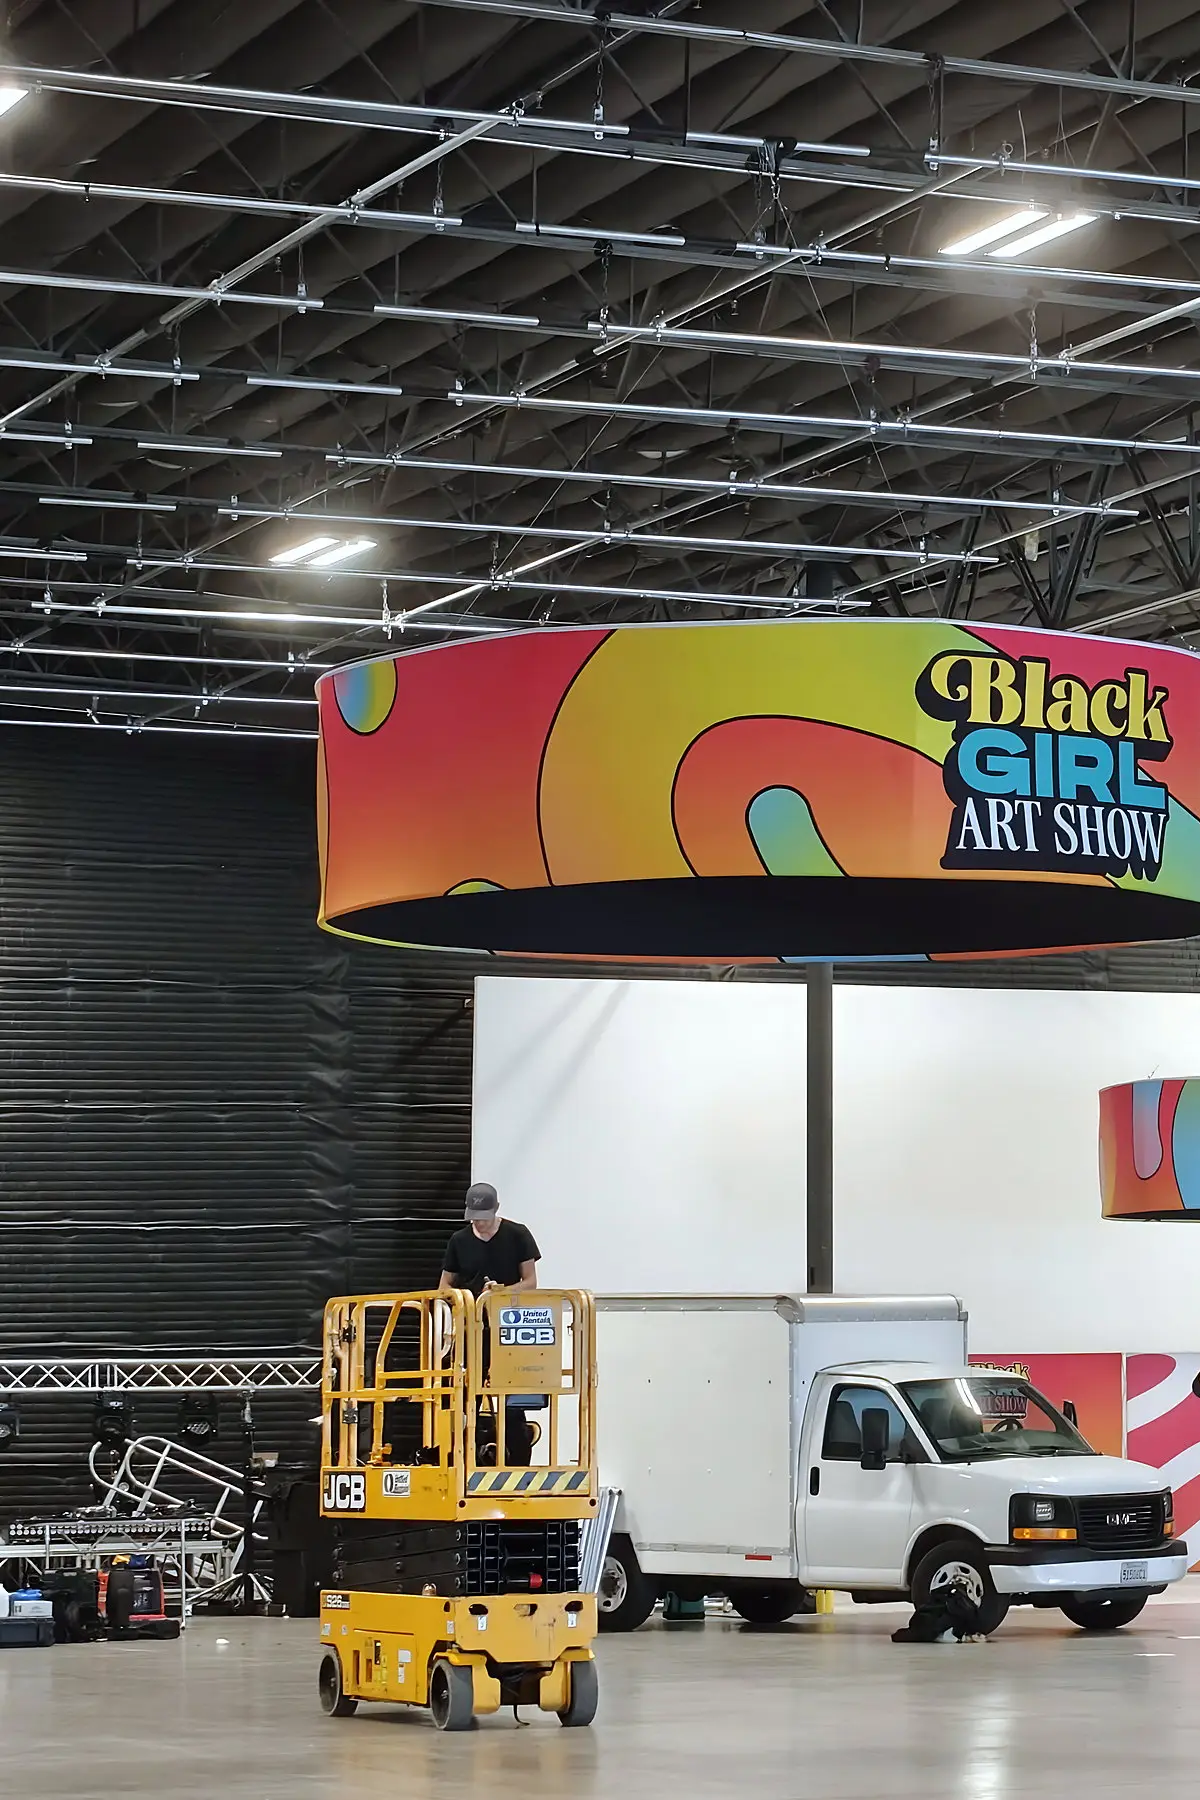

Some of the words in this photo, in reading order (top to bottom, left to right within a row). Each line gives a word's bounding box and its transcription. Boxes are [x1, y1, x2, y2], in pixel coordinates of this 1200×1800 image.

[931, 656, 1170, 743] Black
[958, 728, 1166, 810] GIRL
[956, 797, 1042, 852] ART
[1054, 802, 1167, 864] SHOW
[500, 1328, 555, 1345] JCB
[522, 1310, 549, 1318] United
[323, 1474, 366, 1509] JCB
